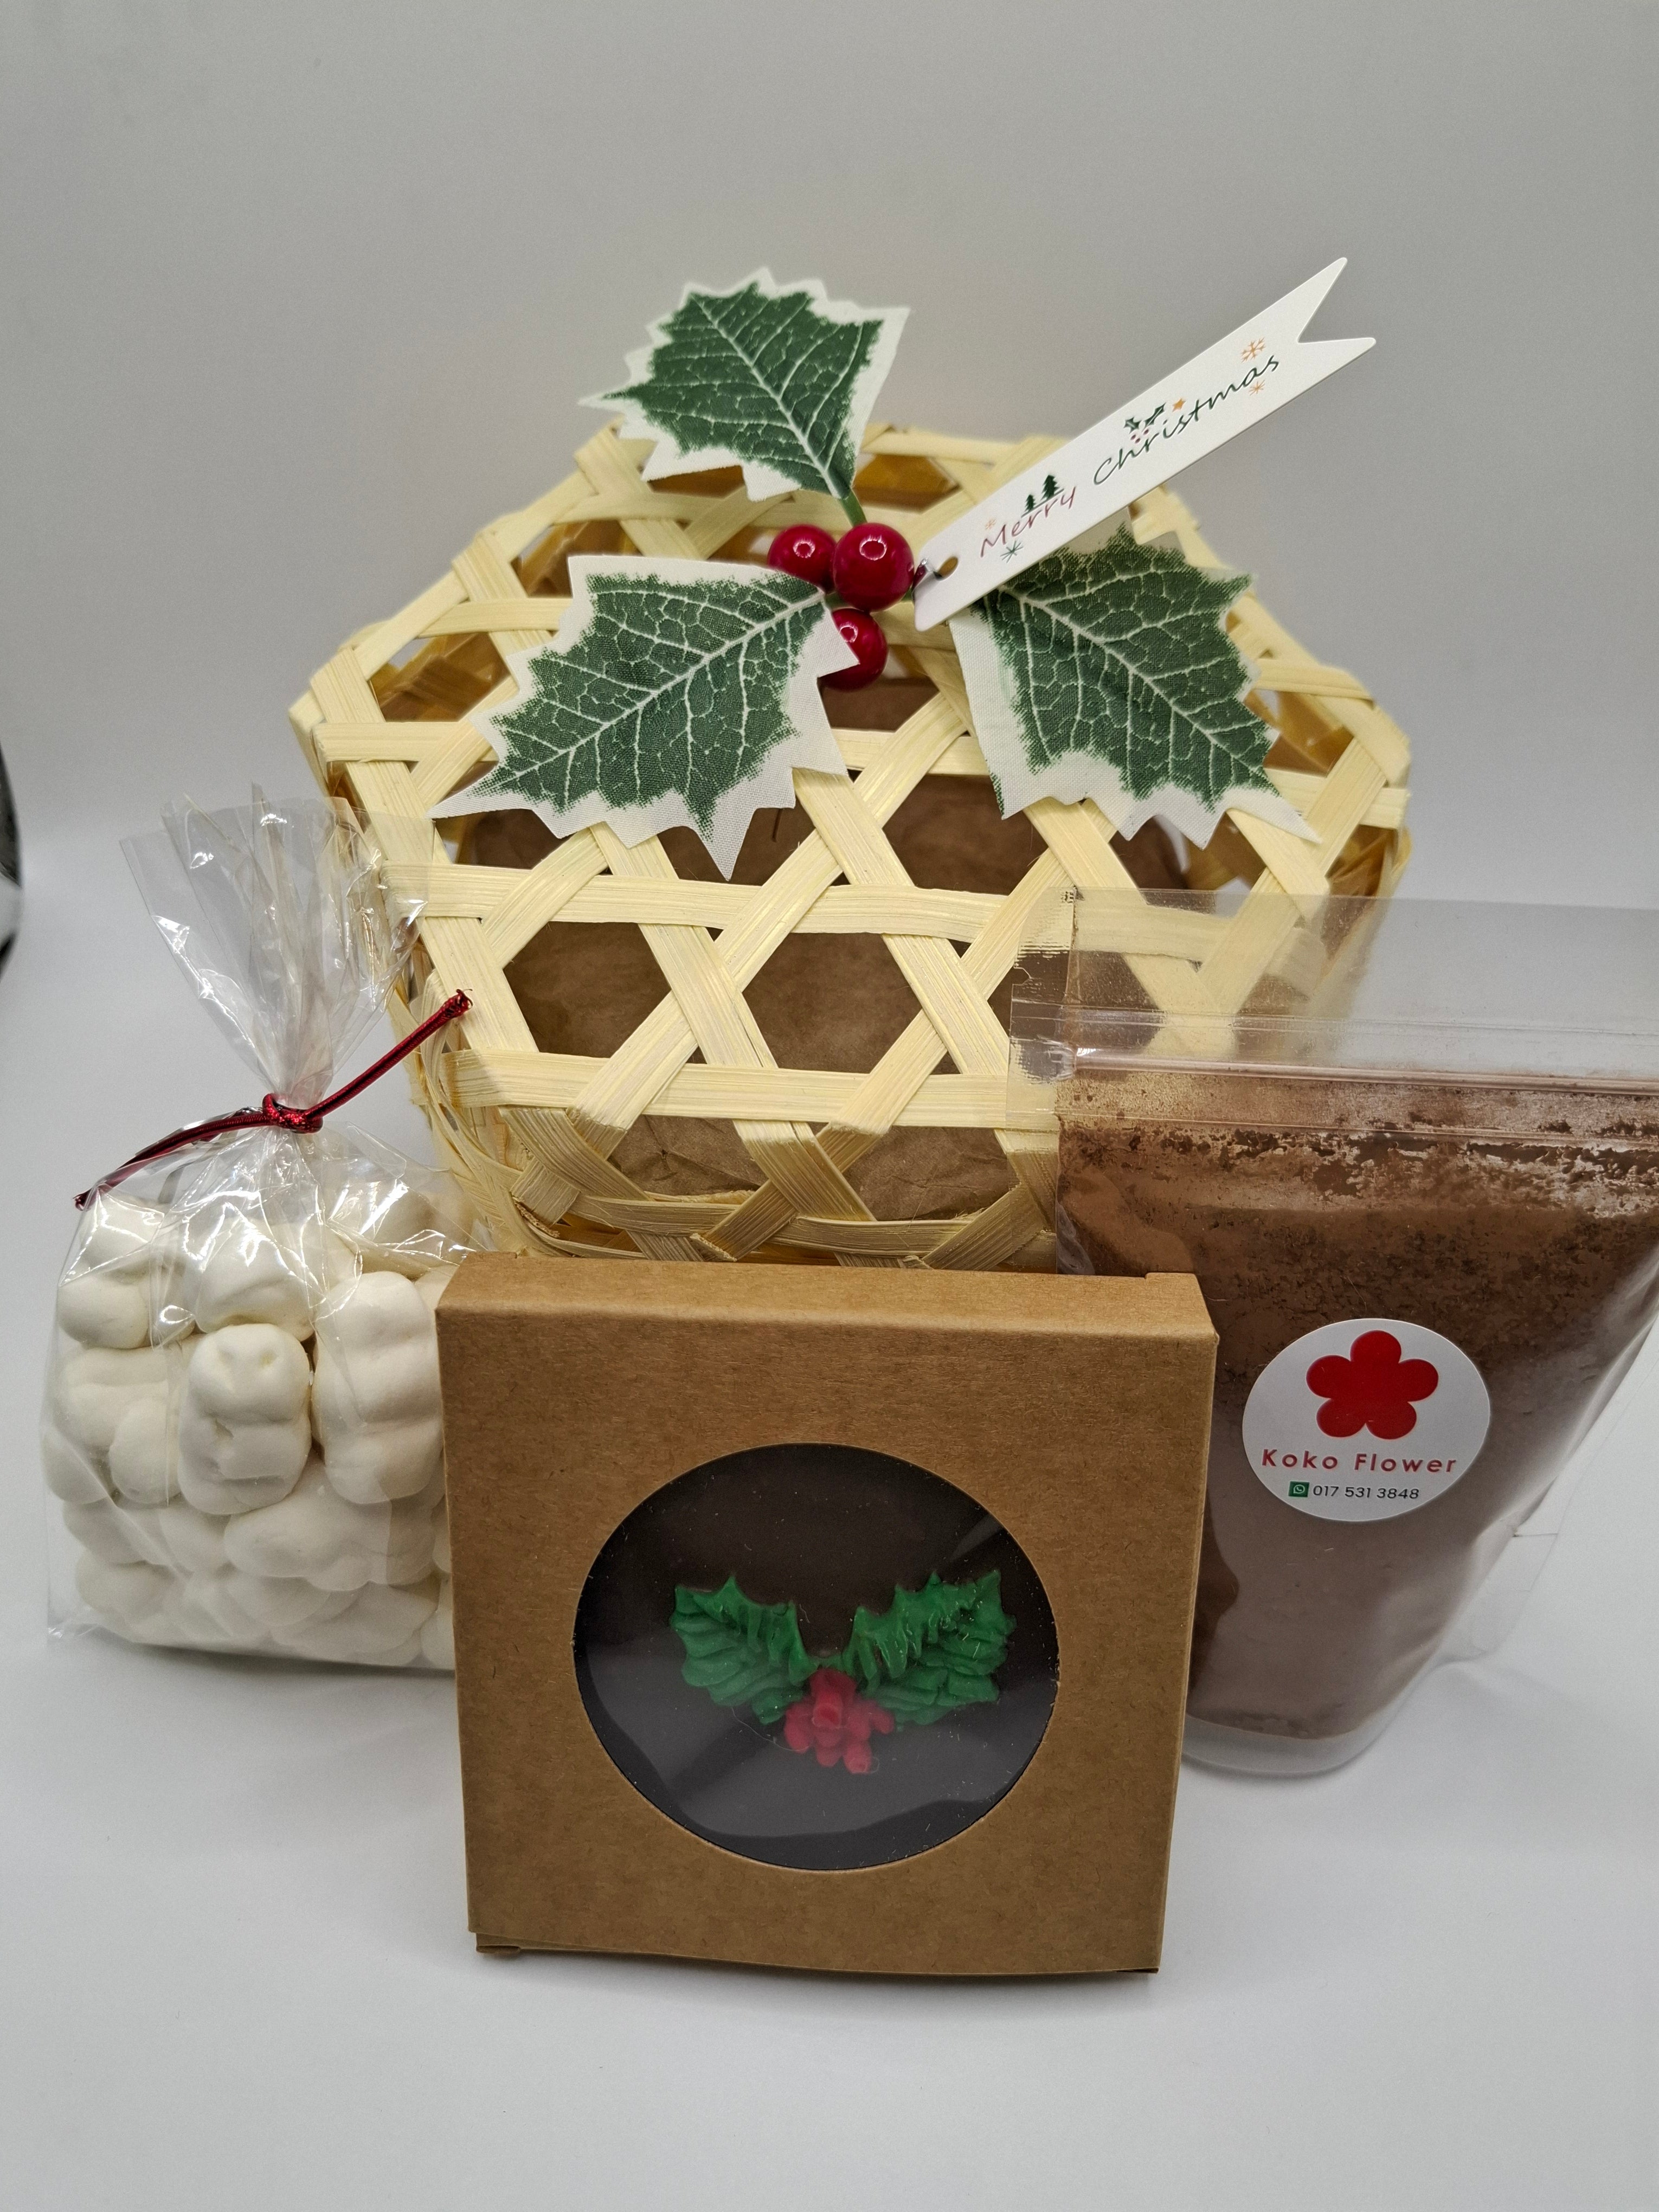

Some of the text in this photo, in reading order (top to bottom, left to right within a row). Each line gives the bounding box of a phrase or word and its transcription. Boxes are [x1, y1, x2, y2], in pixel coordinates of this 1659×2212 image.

[979, 355, 1280, 558] Merry Christmas
[1261, 1448, 1457, 1473] Koko Flower
[1312, 1484, 1419, 1500] 017 531 3848
